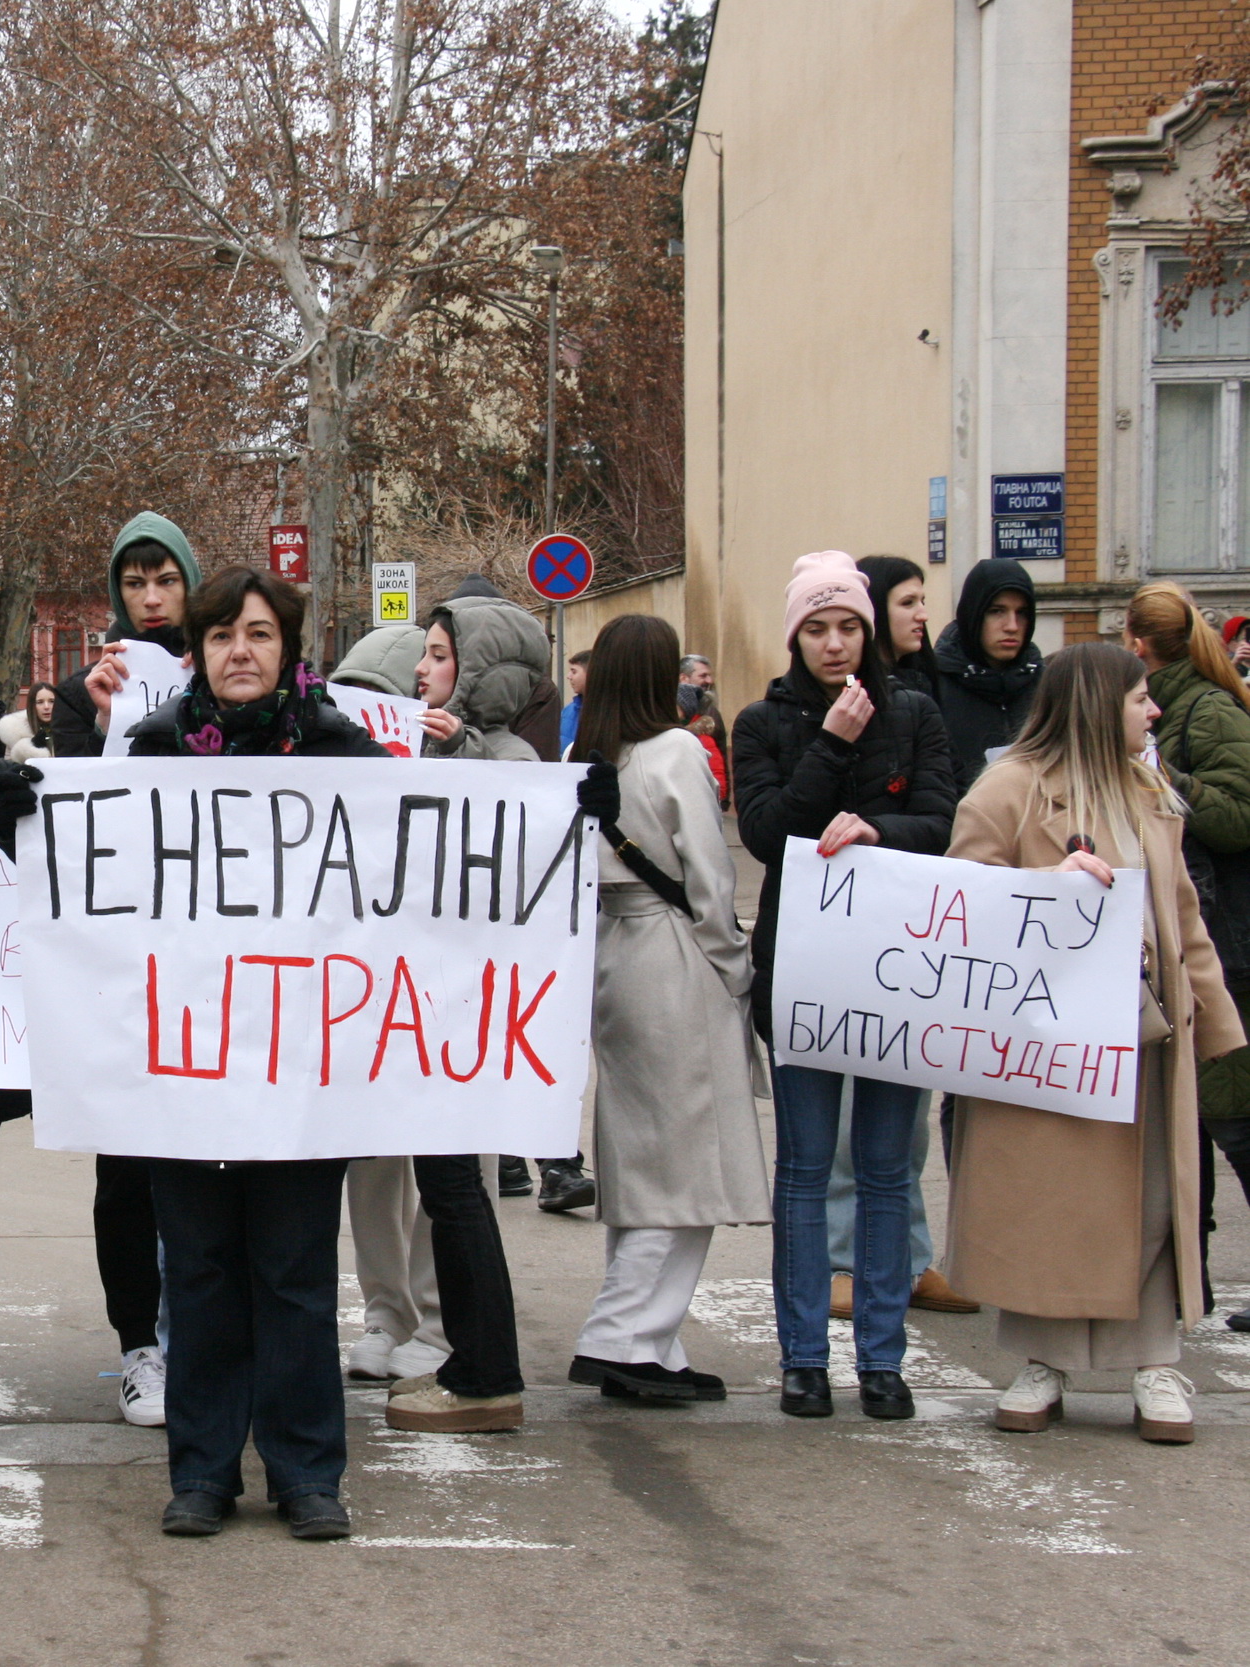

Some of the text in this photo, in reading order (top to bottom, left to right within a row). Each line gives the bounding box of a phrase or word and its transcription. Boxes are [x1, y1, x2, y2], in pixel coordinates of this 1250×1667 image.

[994, 481, 1063, 495] ГЛАВНА УЛИЦА
[1023, 496, 1048, 508] UTCA
[999, 539, 1019, 550] TITO
[376, 579, 410, 589] ШКОЛЕ
[379, 569, 406, 578] ЗОНА
[41, 787, 585, 936] ГЕНЕРАЛНИ
[819, 862, 1106, 950] И ЈА ЋУ
[875, 947, 1058, 1021] СУТРА
[146, 952, 557, 1086] ШТРАЈК
[788, 1000, 1135, 1098] БИТИ СТУДЕНТ
